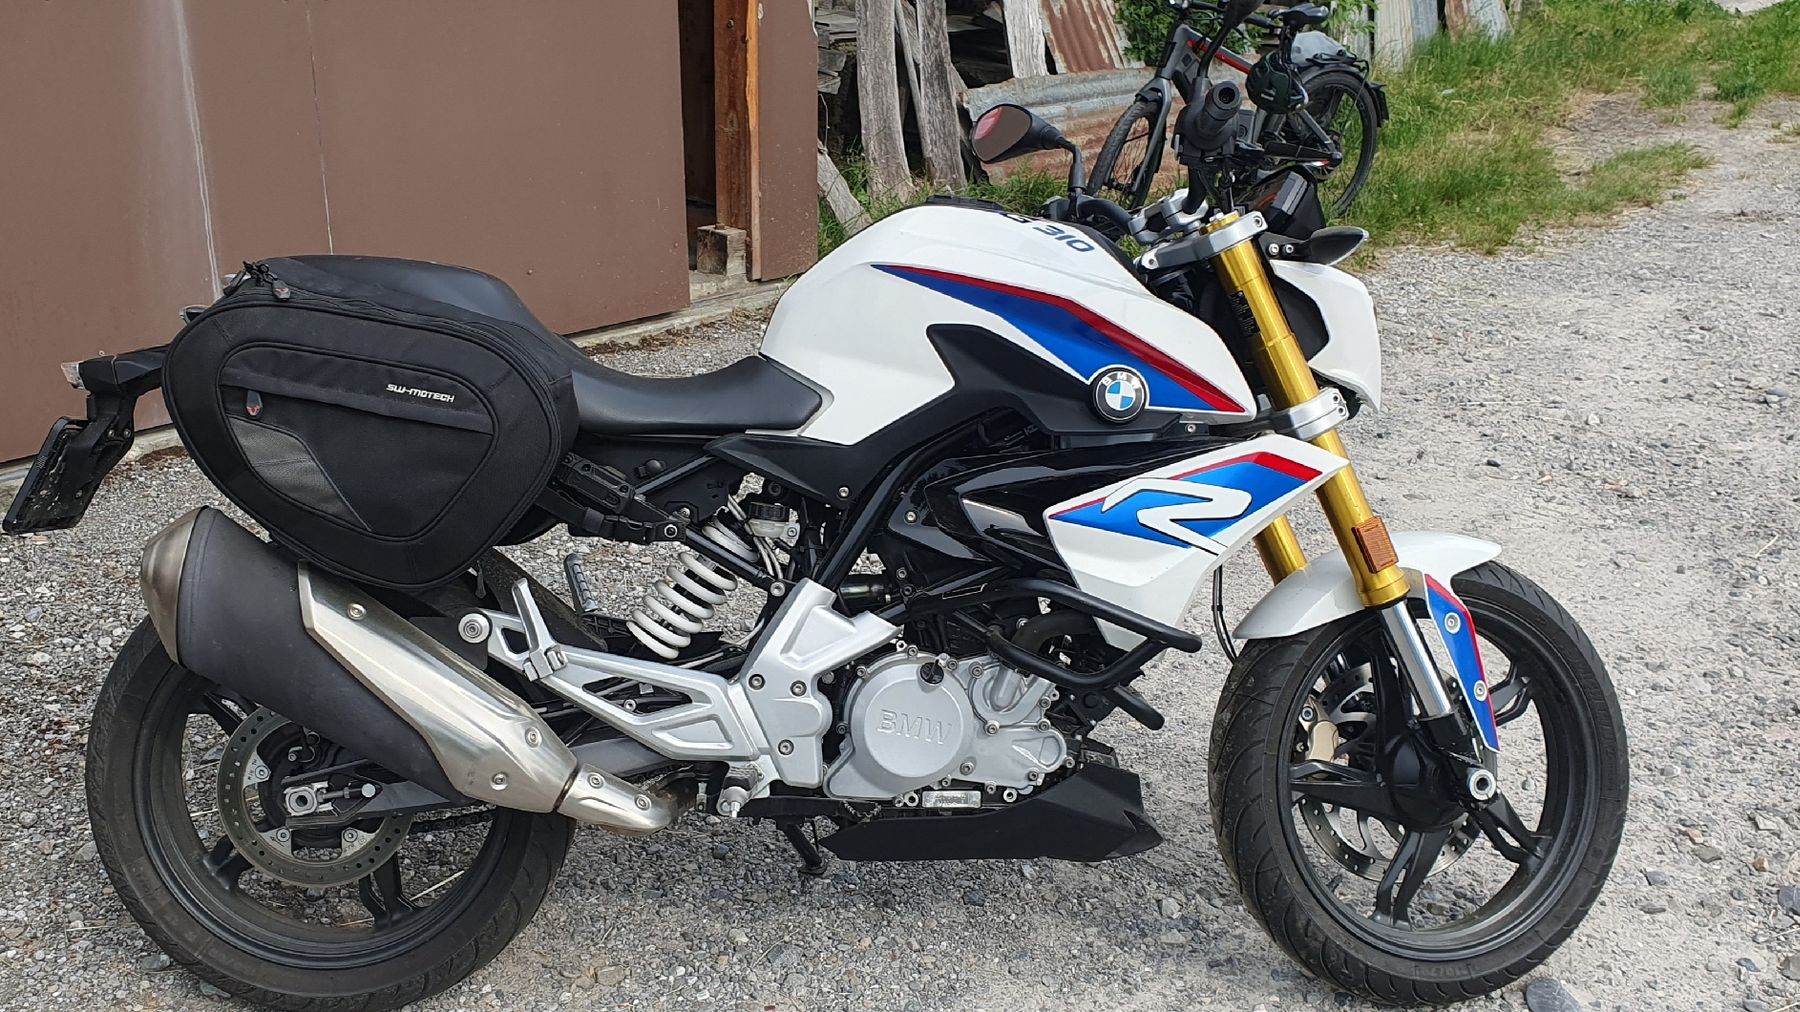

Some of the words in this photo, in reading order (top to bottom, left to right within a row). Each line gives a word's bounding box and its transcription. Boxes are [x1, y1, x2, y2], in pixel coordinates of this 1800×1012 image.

[1032, 224, 1096, 252] 310
[1100, 371, 1142, 389] BMW
[385, 383, 455, 403] SW-MOTECH
[876, 708, 953, 745] BMW
